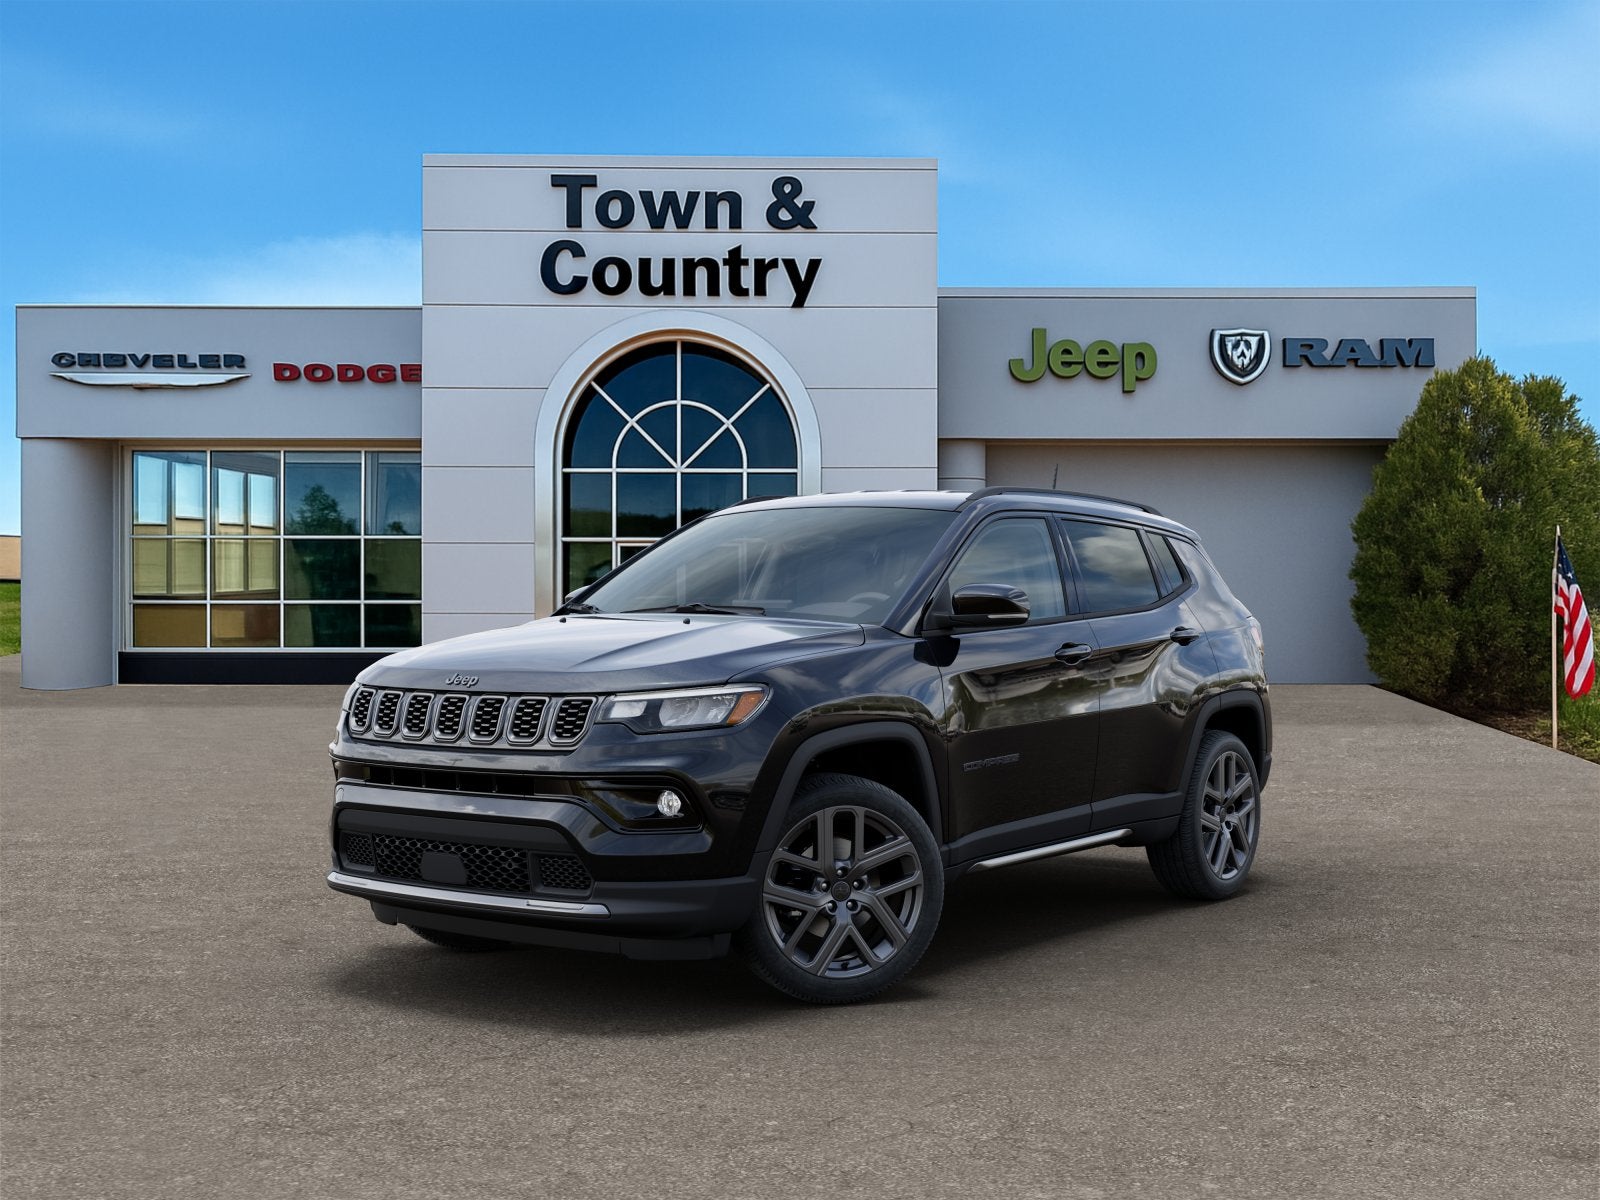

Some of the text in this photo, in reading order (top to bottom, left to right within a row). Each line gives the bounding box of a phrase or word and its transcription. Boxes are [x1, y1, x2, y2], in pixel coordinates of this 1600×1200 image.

[550, 174, 818, 229] Town &
[540, 239, 822, 308] Country
[273, 362, 422, 383] DODGE
[1008, 327, 1158, 393] Jeep
[1282, 337, 1436, 368] RAM
[445, 672, 480, 688] Jeep
